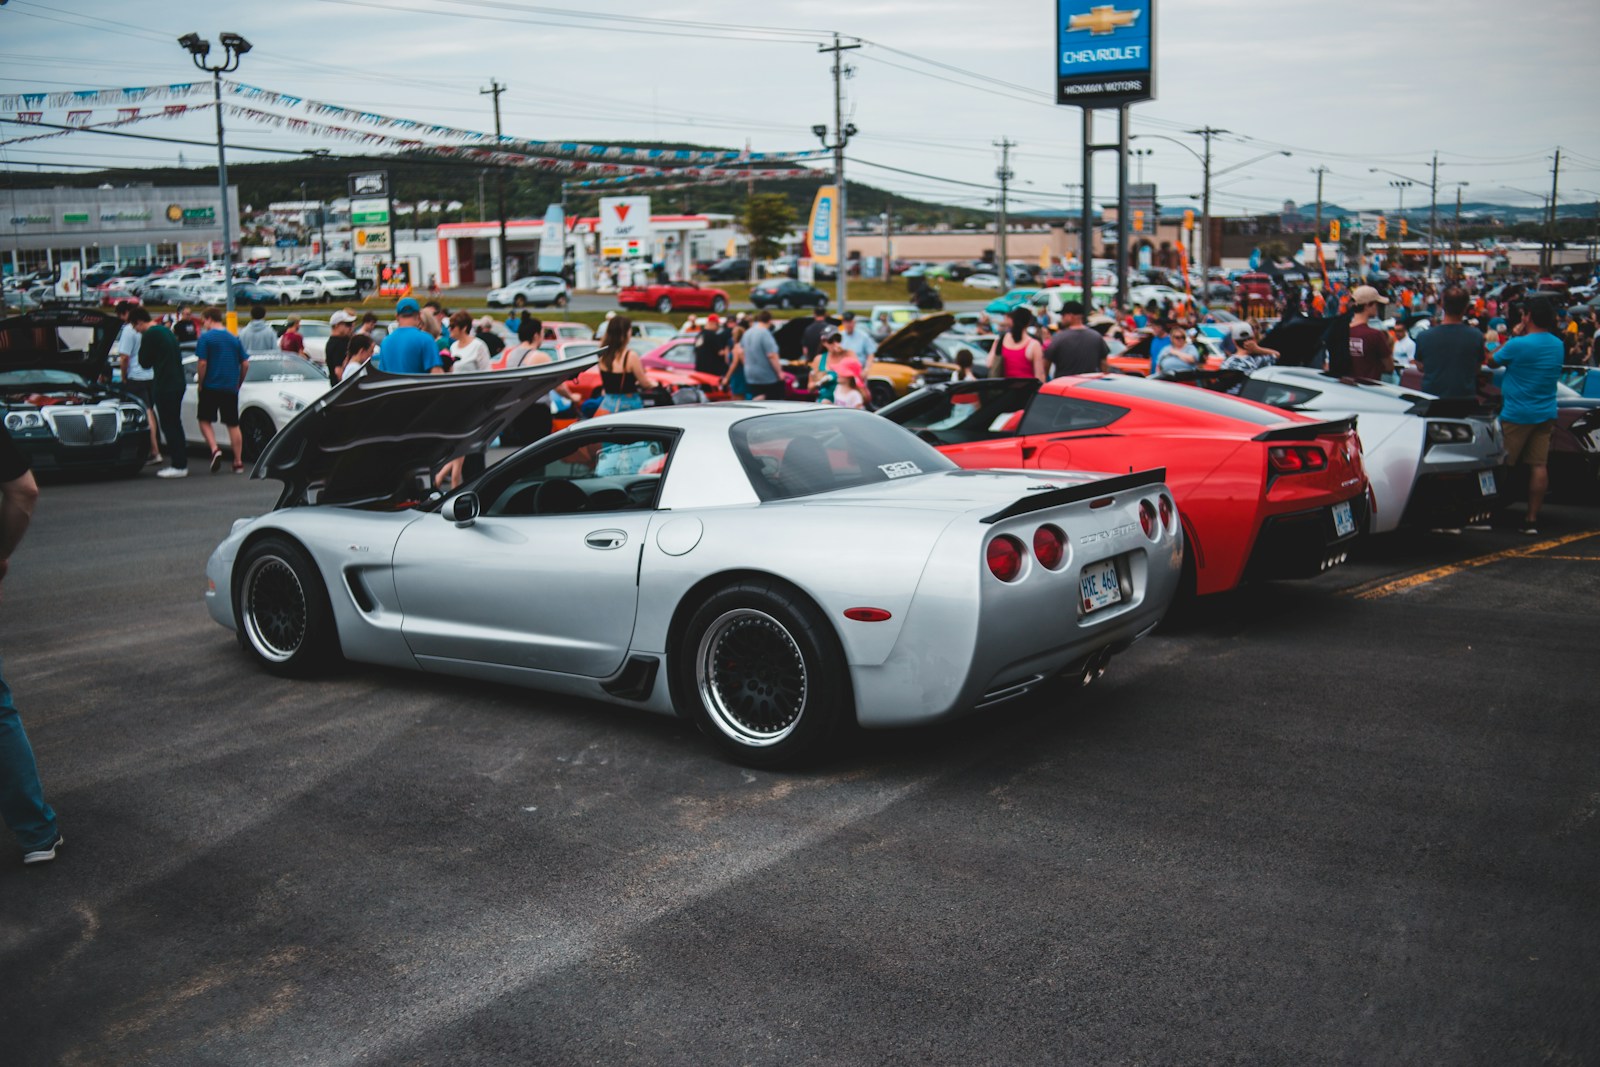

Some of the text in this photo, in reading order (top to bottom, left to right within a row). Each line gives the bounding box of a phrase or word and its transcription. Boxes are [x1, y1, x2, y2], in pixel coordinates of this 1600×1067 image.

[1062, 45, 1143, 64] CHEVROLET
[1105, 80, 1142, 92] MOTORS
[1080, 522, 1137, 545] CORVETTE
[1081, 569, 1117, 598] HXE 460
